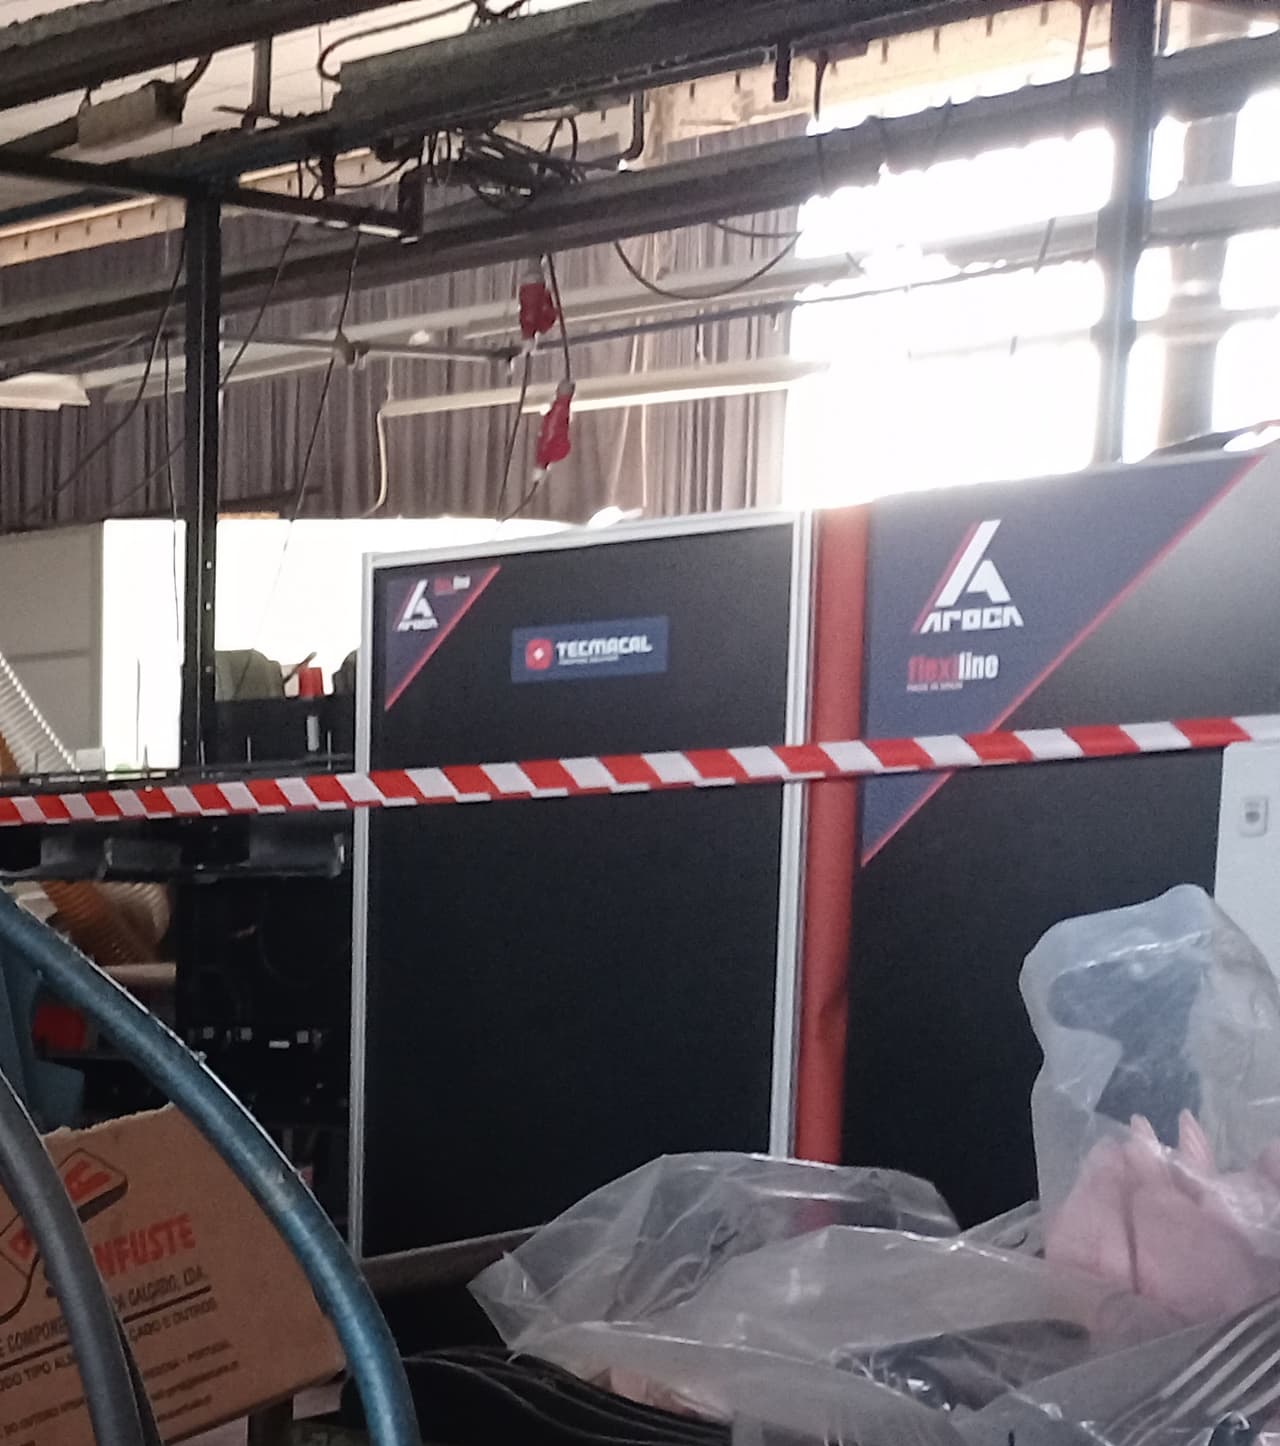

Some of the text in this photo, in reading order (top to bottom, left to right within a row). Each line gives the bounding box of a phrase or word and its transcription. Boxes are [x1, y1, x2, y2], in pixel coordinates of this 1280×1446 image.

[555, 634, 654, 659] TECMACAL
[93, 1212, 196, 1279] NFUSTE
[23, 1360, 52, 1381] TIPO
